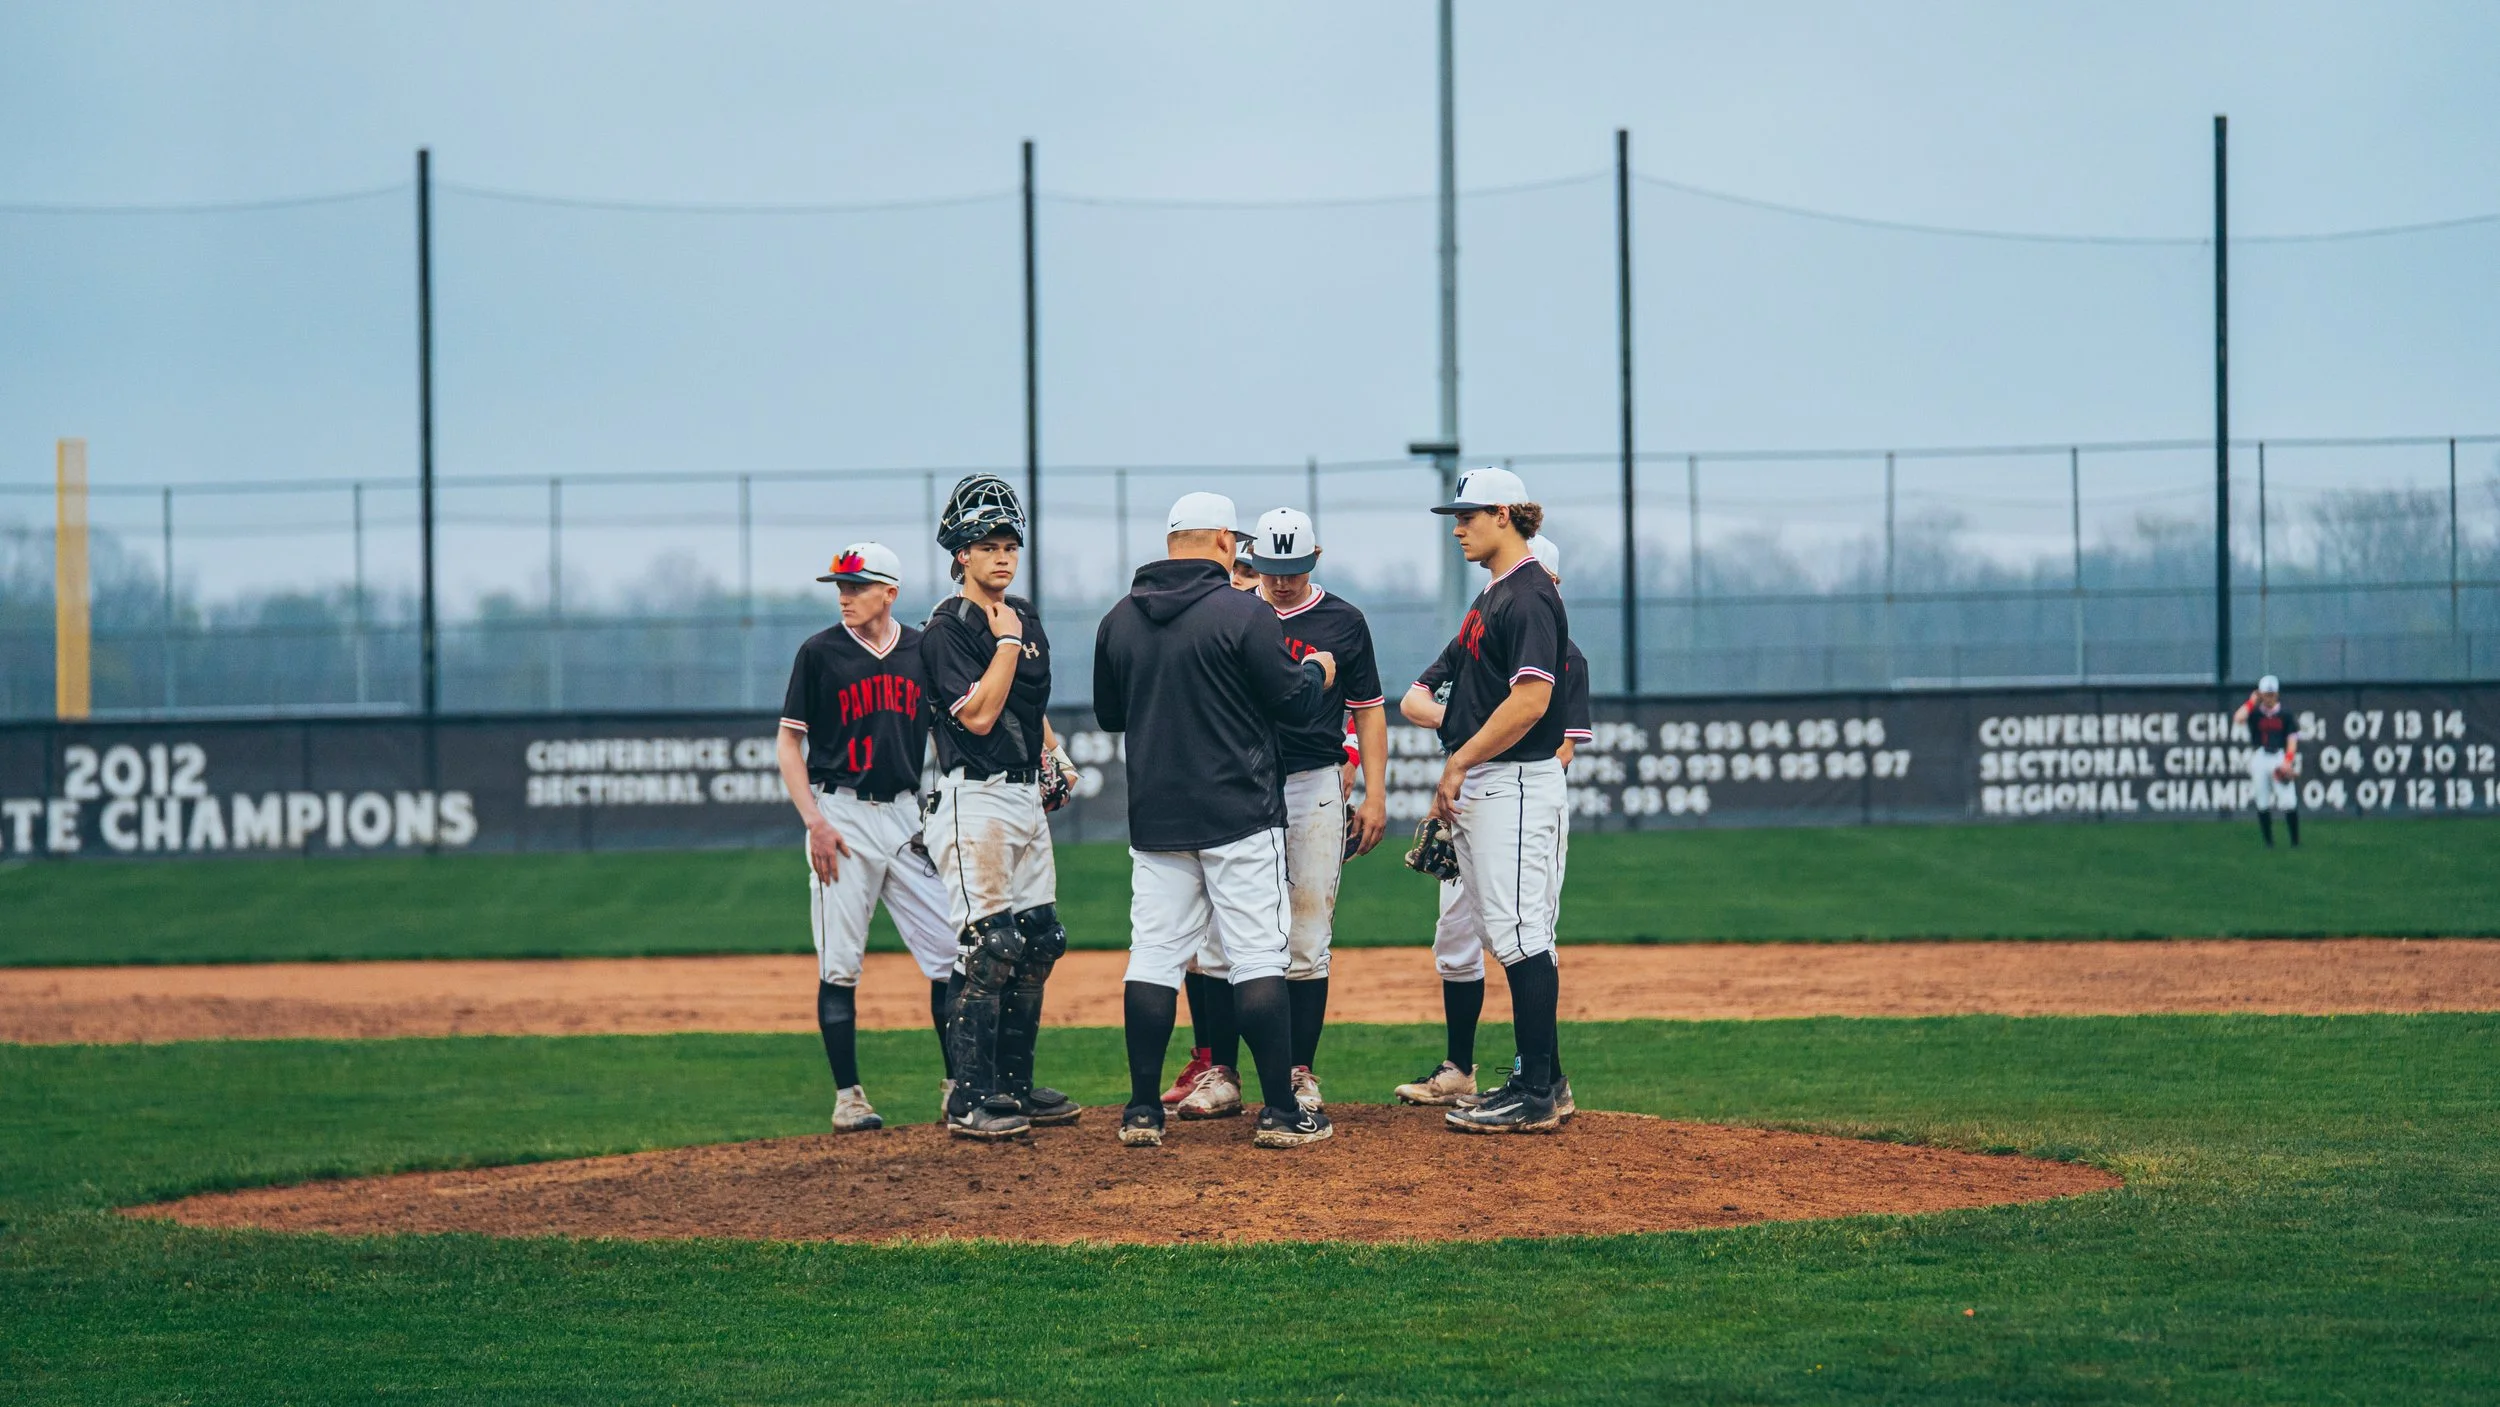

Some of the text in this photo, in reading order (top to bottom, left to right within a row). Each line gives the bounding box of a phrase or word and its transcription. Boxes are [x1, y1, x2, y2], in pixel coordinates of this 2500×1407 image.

[1273, 533, 1294, 554] W
[1979, 711, 2179, 747] CONFERENCE
[2343, 709, 2384, 741] 07
[2394, 709, 2422, 741] 13
[2433, 709, 2466, 740] 14
[64, 743, 207, 799] 2012
[526, 736, 731, 772] CONFERENCE
[847, 735, 874, 773] 11
[1980, 747, 2155, 781] SECTIONAL
[2320, 745, 2364, 775] 04
[2373, 744, 2412, 774] 07
[2423, 744, 2456, 773] 10
[2466, 743, 2495, 773] 12
[526, 771, 706, 806] SECTIONAL
[1981, 780, 2139, 816] REGIONAL
[2303, 778, 2347, 812] 04
[2356, 778, 2396, 811] 07
[2406, 777, 2436, 810] 12
[2444, 777, 2475, 810] 13
[2484, 777, 2500, 810] 1
[0, 790, 478, 853] TE CHAMPIONS
